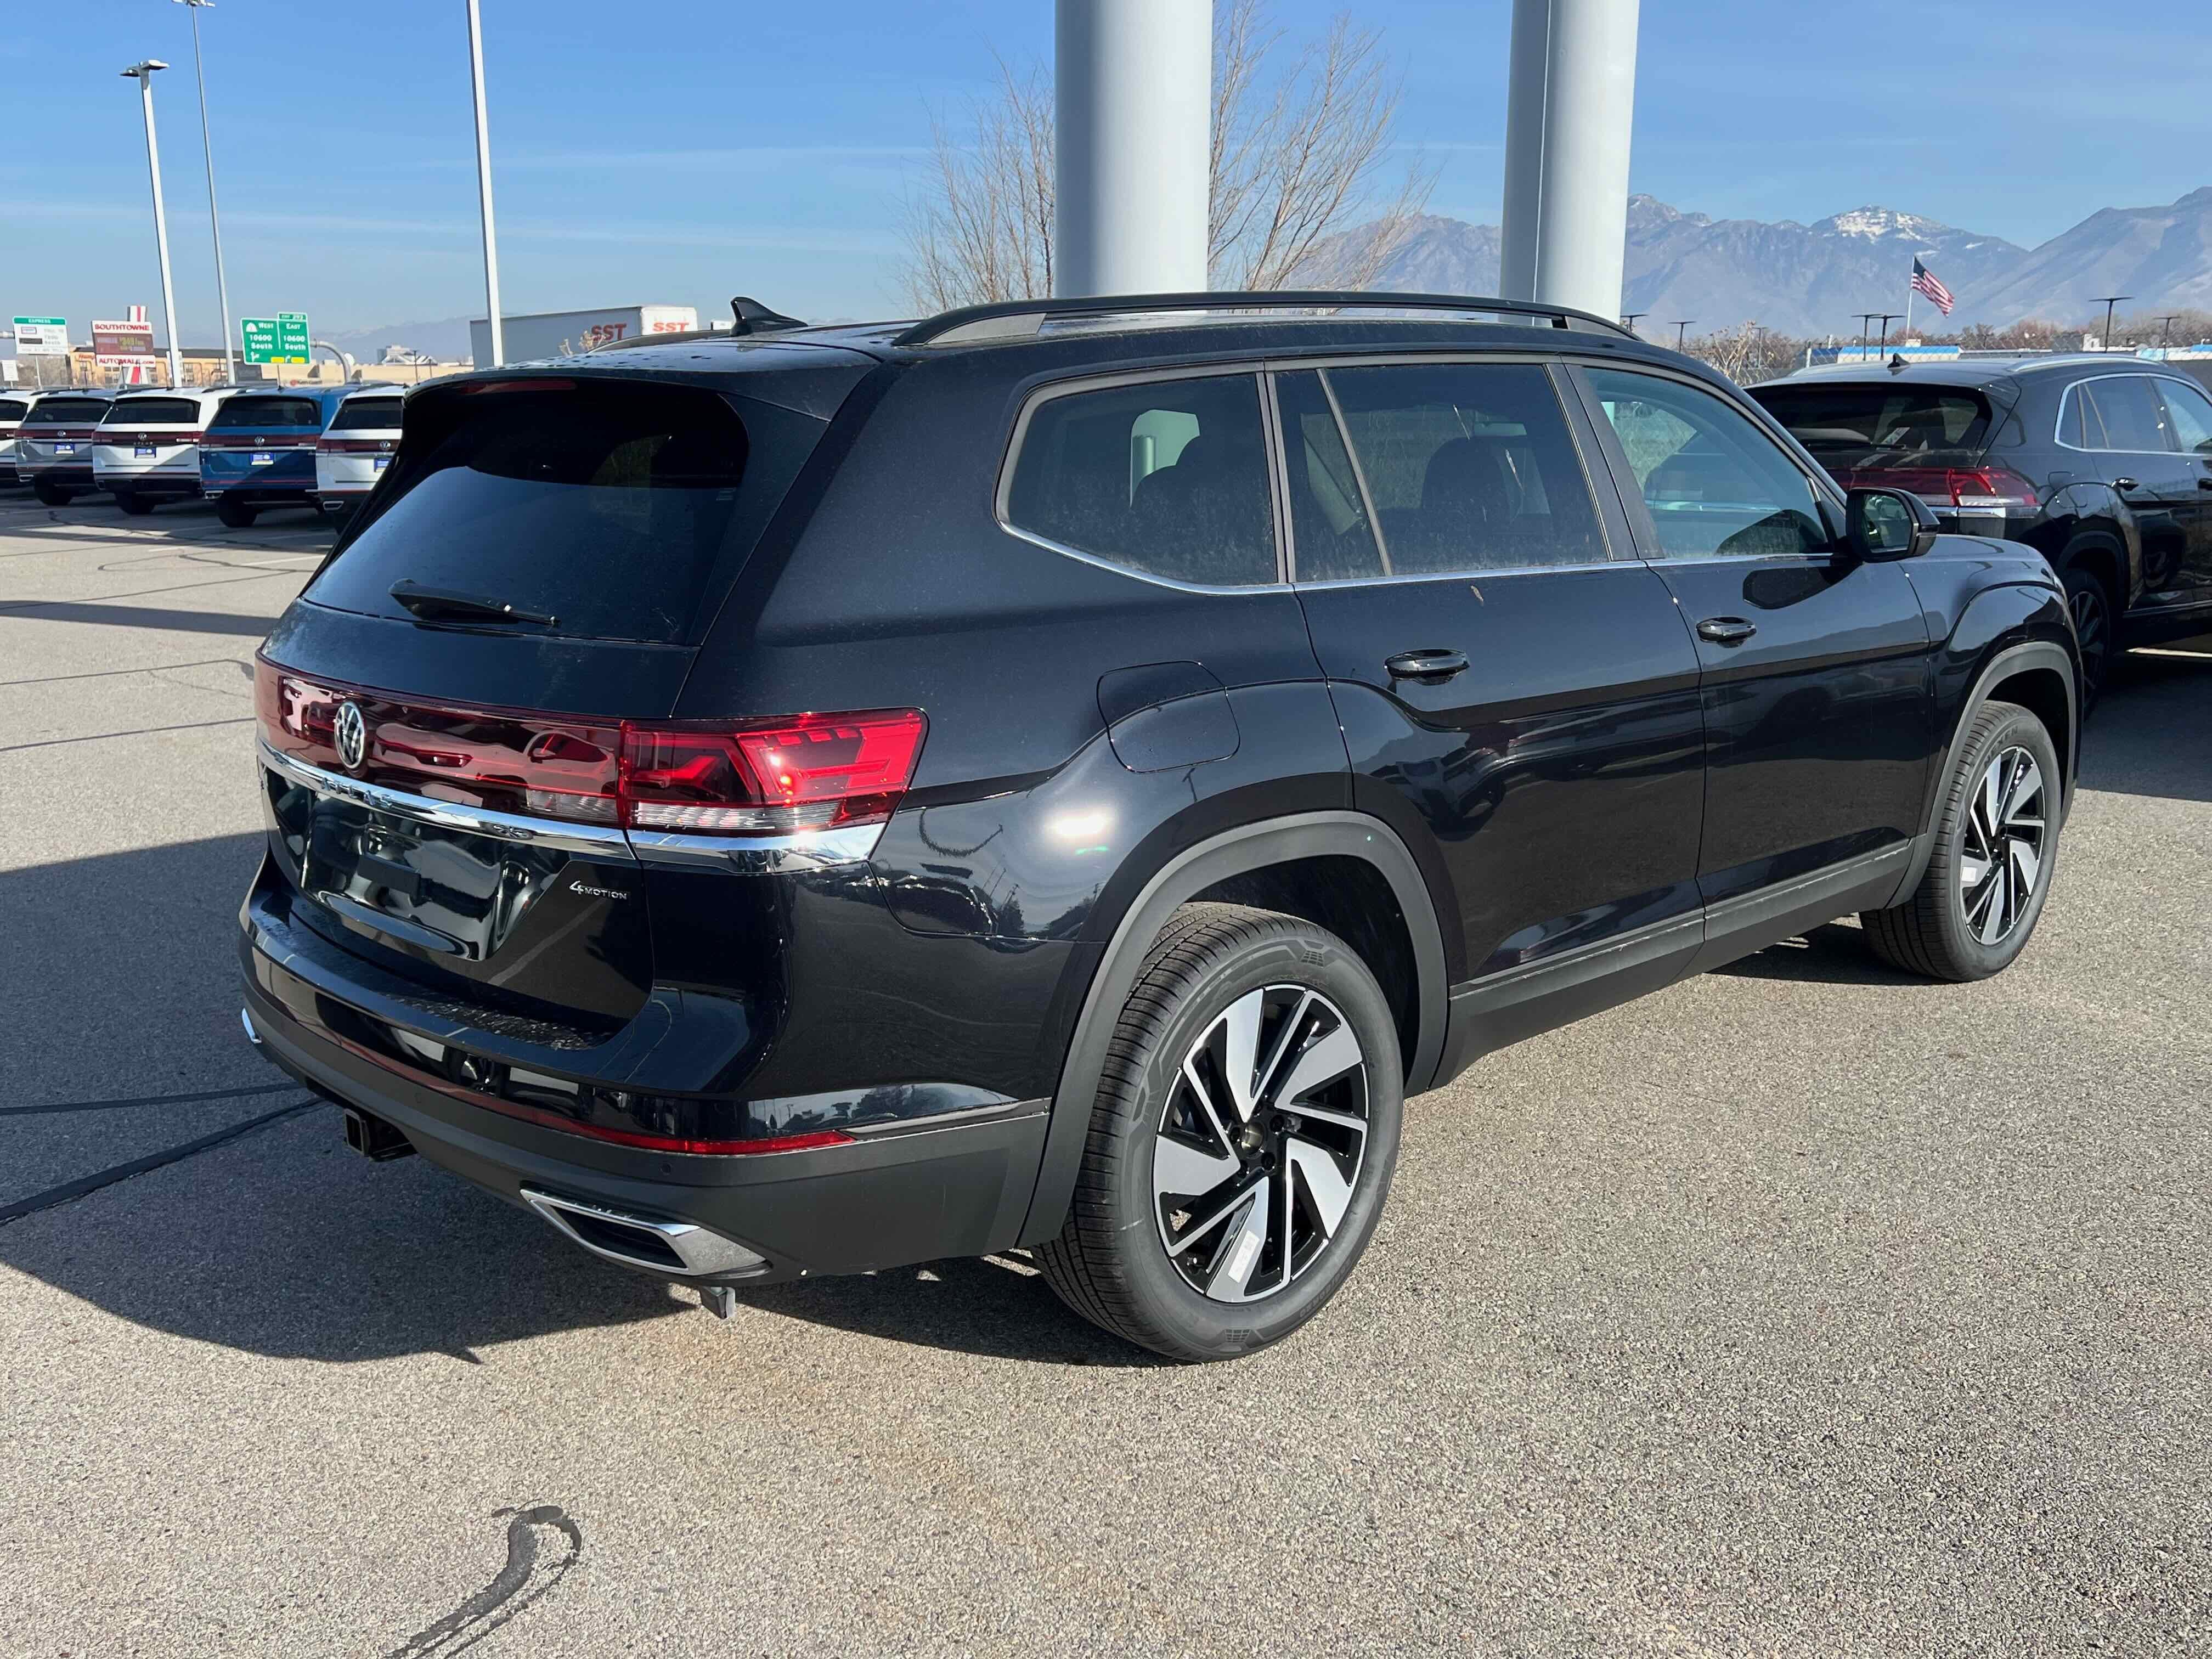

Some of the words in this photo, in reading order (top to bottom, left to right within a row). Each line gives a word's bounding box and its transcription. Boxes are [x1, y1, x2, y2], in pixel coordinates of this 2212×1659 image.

[591, 323, 627, 341] SST
[653, 322, 689, 332] SST
[320, 776, 393, 809] ATLAS
[569, 880, 627, 900] 4MOTION
